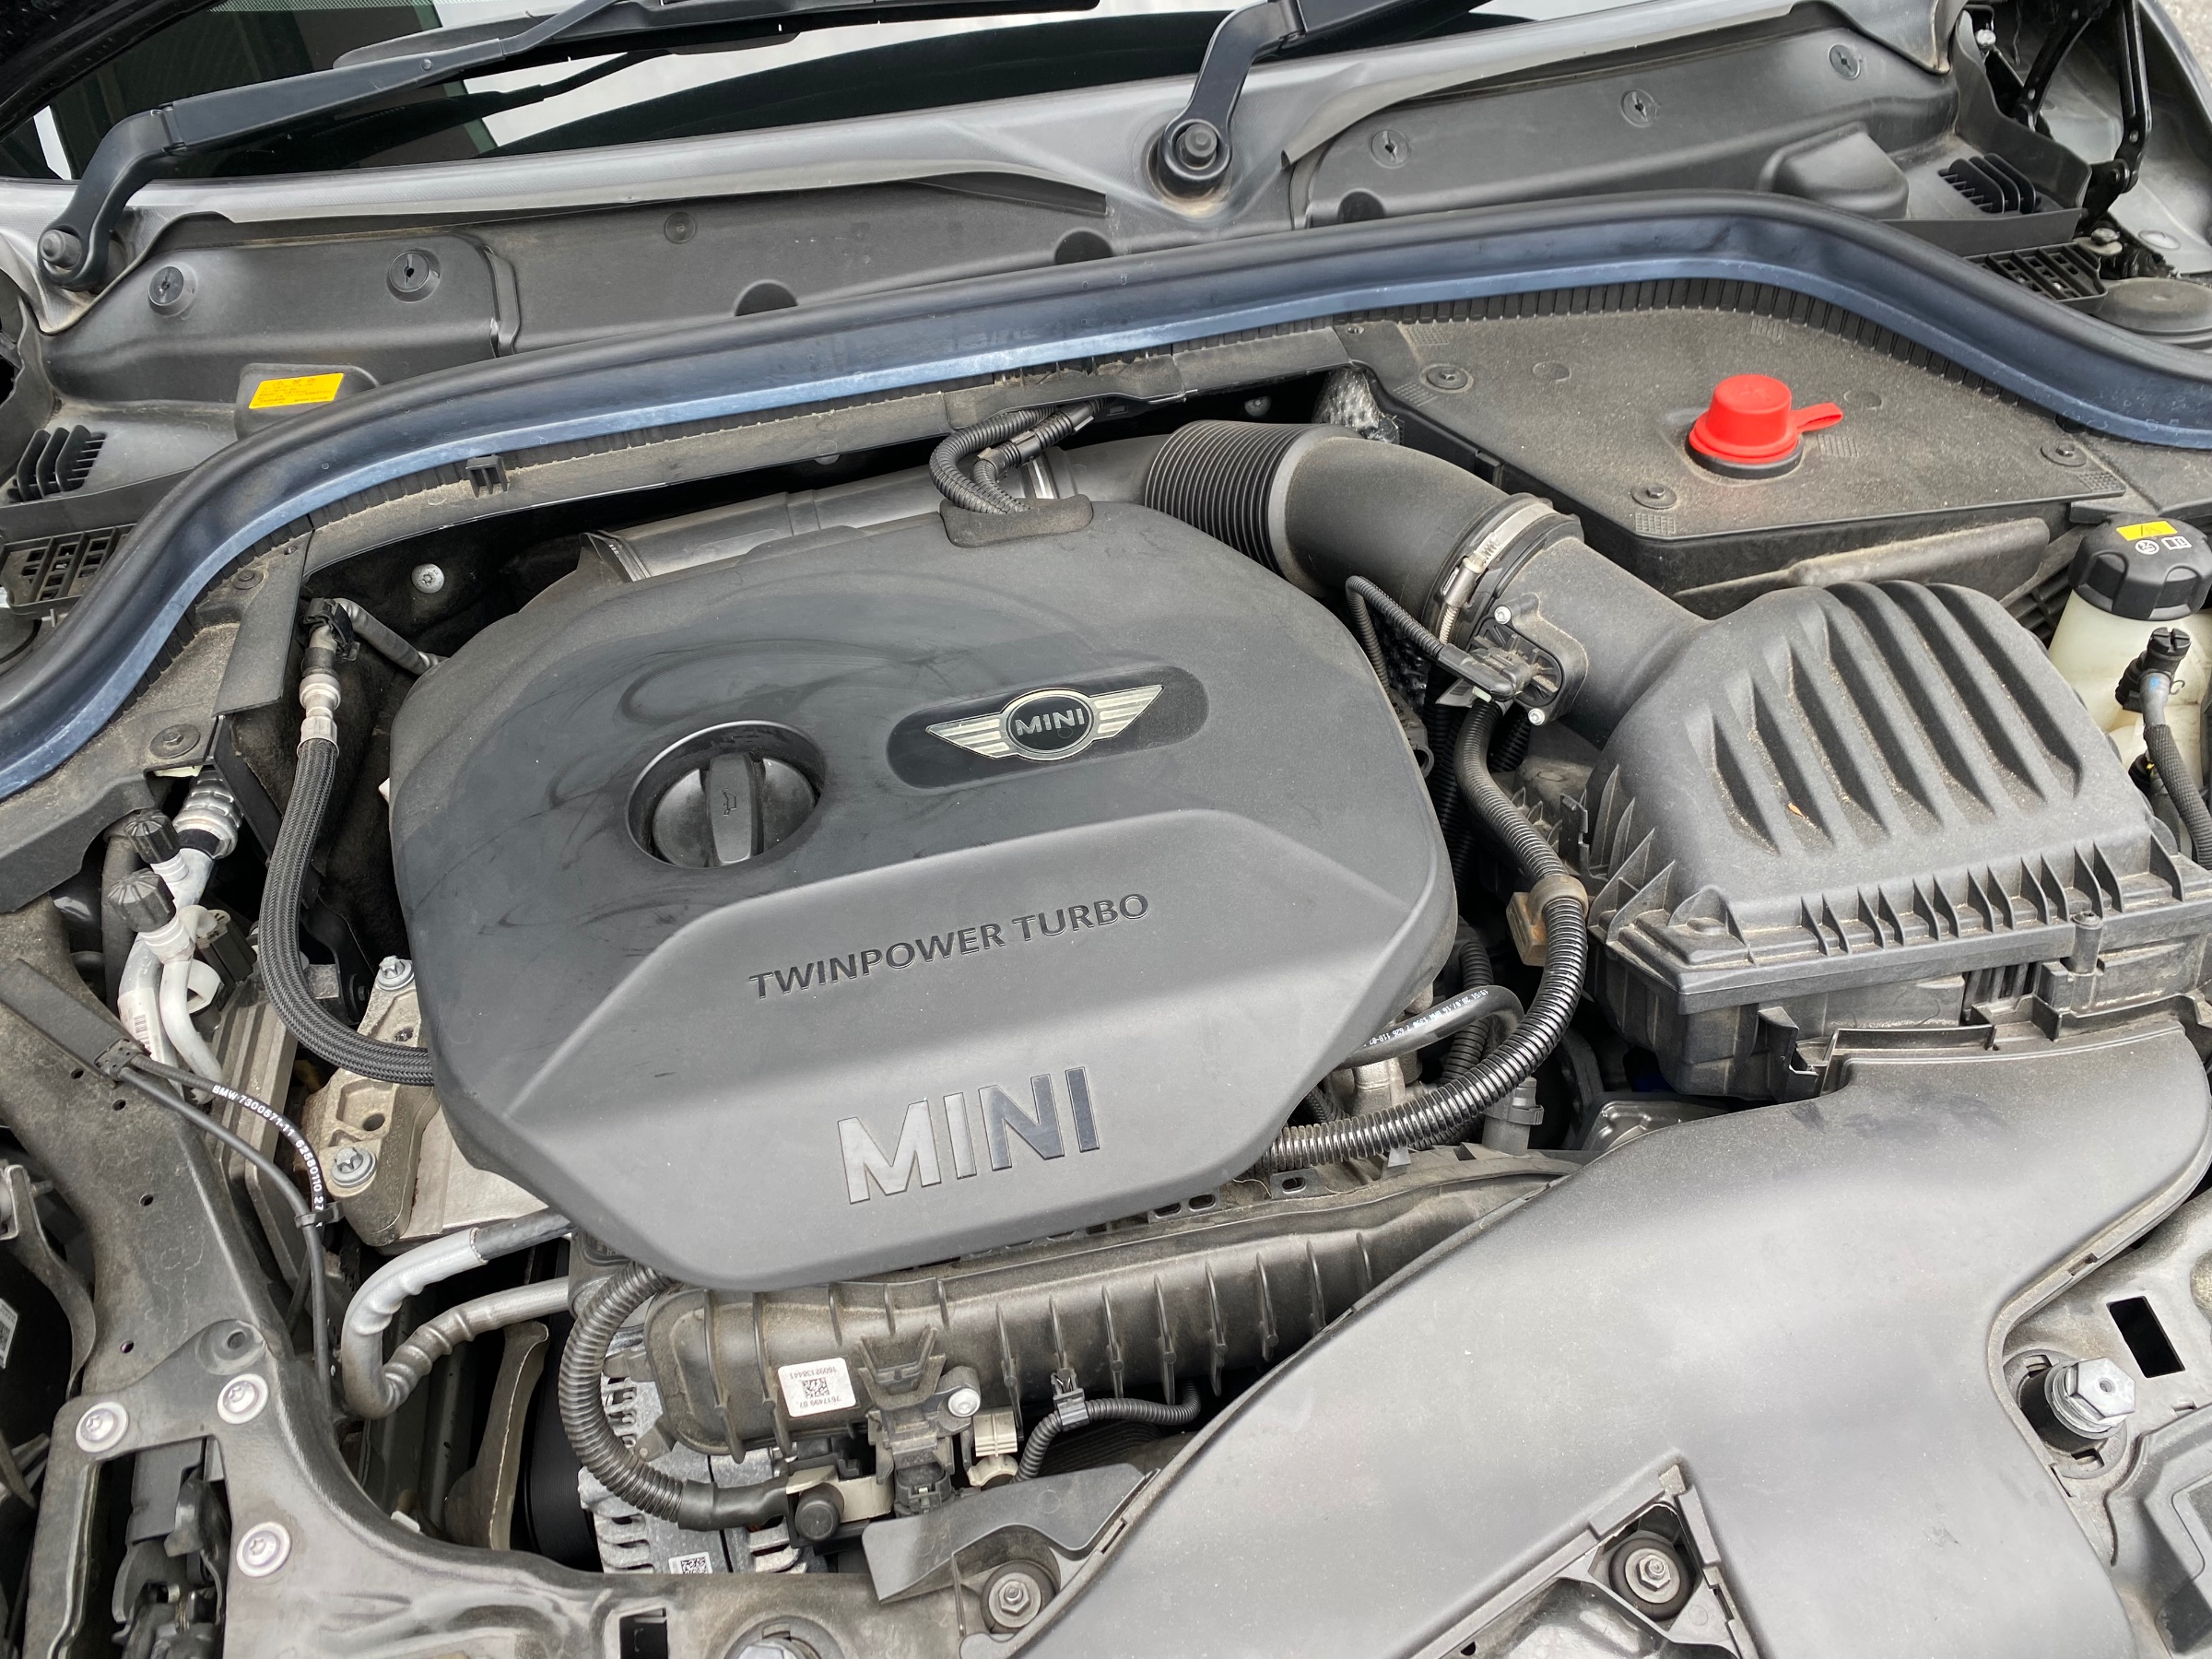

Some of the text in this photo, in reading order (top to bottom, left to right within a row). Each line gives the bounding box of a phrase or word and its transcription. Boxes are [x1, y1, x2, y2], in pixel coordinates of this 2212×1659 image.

[1015, 708, 1085, 736] MINI
[748, 893, 1150, 1000] TWINPOWER TURBO
[212, 1085, 239, 1100] BMW
[239, 1094, 295, 1137] 7300571-11
[295, 1139, 323, 1193] 62580110
[838, 1066, 1100, 1205] MINI
